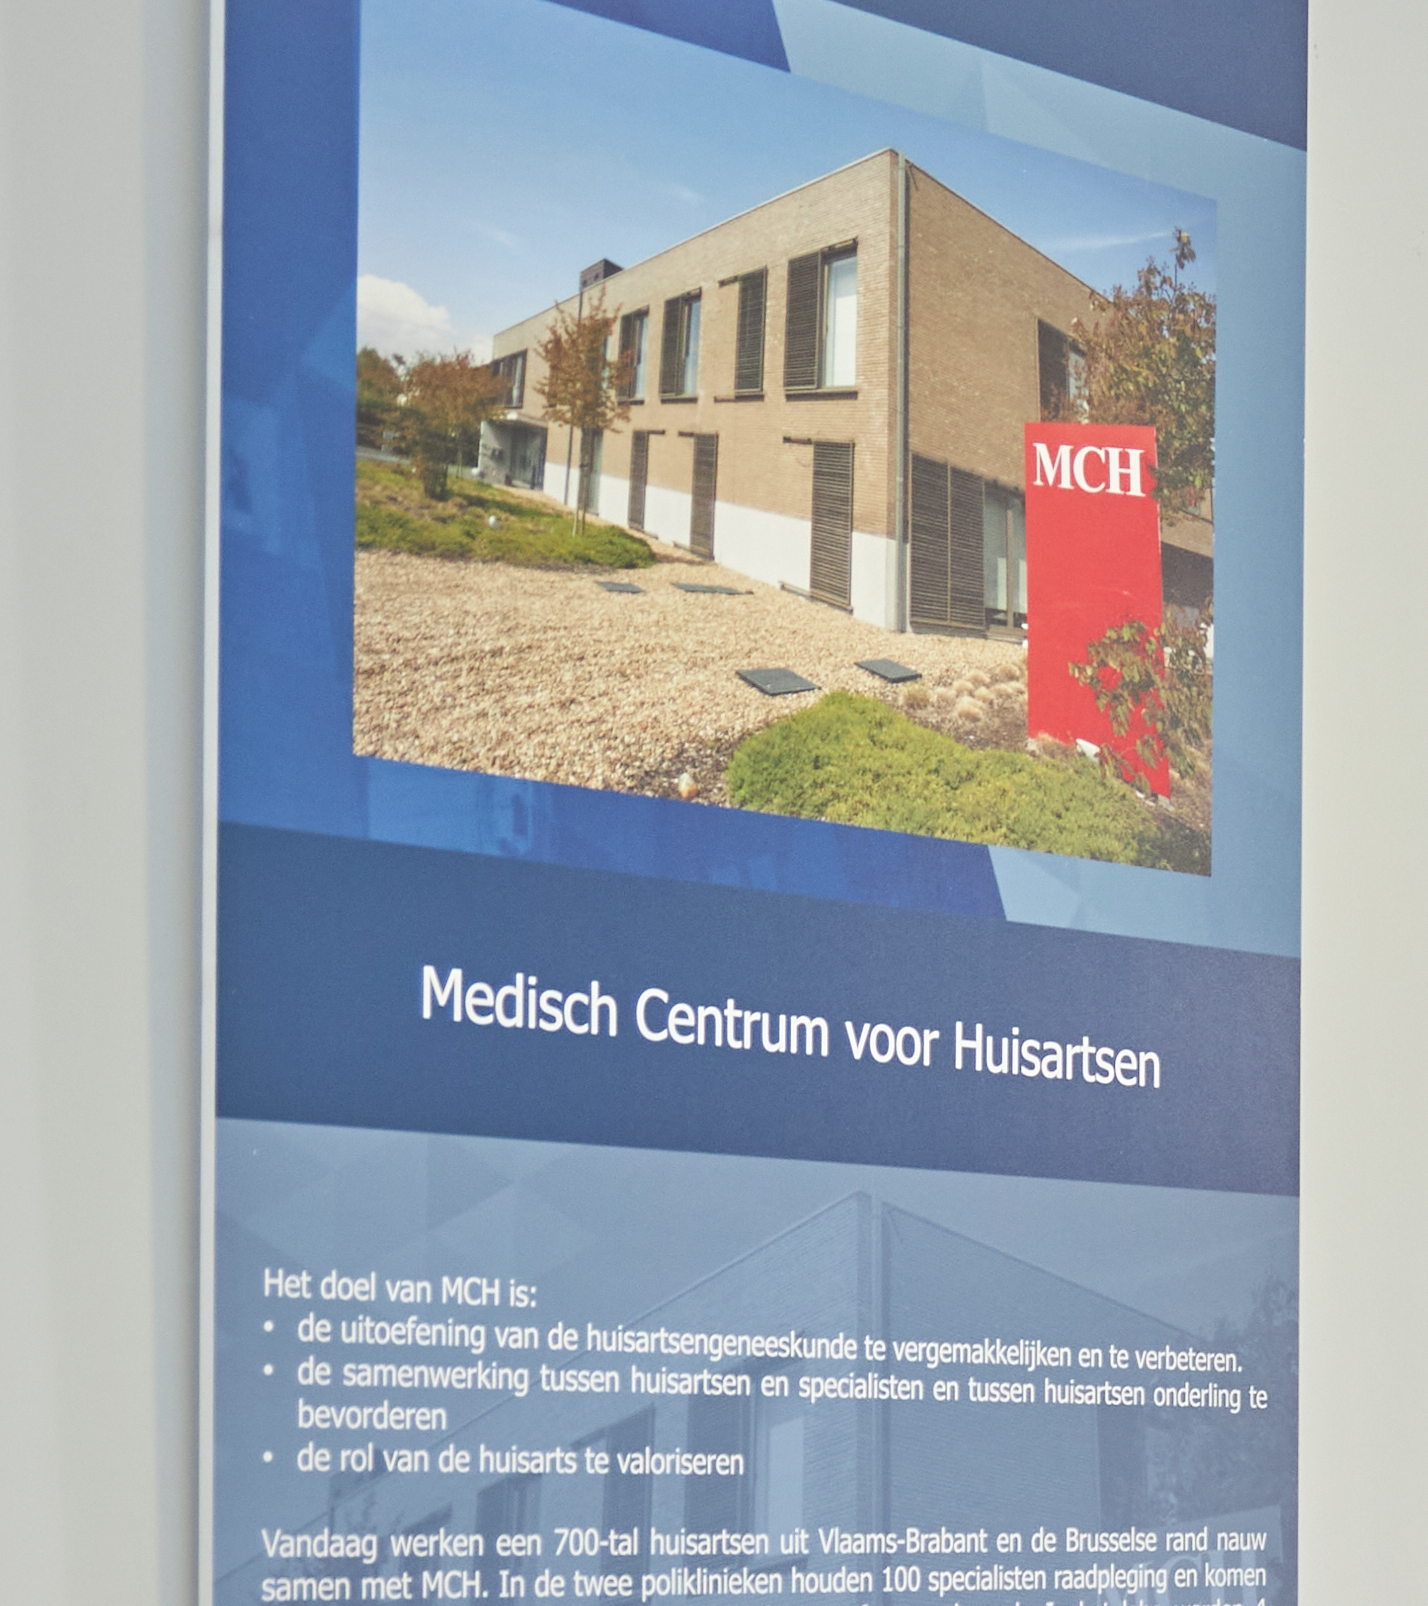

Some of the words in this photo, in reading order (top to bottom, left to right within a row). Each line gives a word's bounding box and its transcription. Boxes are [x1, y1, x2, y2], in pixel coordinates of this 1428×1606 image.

[1033, 443, 1146, 497] MCH
[422, 965, 617, 1037] Medisch
[635, 988, 829, 1057] Centrum
[844, 1021, 940, 1067] voor
[955, 1021, 1160, 1089] Huisartsen
[264, 1267, 312, 1299] Het
[320, 1269, 376, 1301] doel
[385, 1279, 431, 1303] van
[441, 1275, 500, 1306] MCH
[509, 1278, 536, 1308] is:
[297, 1311, 331, 1342] de
[341, 1314, 485, 1354] uitoefening
[494, 1326, 538, 1349] van
[547, 1321, 578, 1351] de
[586, 1322, 857, 1362] huisartsengeneeskunde
[863, 1334, 886, 1361] te
[892, 1337, 1071, 1372] vergemakkelijken
[1077, 1347, 1102, 1368] en
[1108, 1344, 1129, 1369] te
[1134, 1344, 1242, 1373] verbeteren.
[297, 1354, 331, 1385] de
[343, 1360, 528, 1397] samenwerking
[539, 1364, 619, 1392] tussen
[631, 1364, 751, 1396] huisartsen
[760, 1375, 788, 1397] en
[798, 1371, 923, 1403] specialisten
[932, 1380, 959, 1401] en
[967, 1376, 1035, 1403] tussen
[1044, 1377, 1145, 1406] huisartsen
[1153, 1381, 1241, 1414] onderling
[1248, 1385, 1267, 1409] te
[297, 1397, 446, 1430] bevorderen
[297, 1441, 330, 1472] de
[340, 1442, 373, 1472] rol
[382, 1449, 429, 1472] van
[438, 1443, 470, 1473] de
[479, 1443, 577, 1474] huisarts
[584, 1447, 609, 1474] te
[616, 1445, 744, 1475] valoriseren
